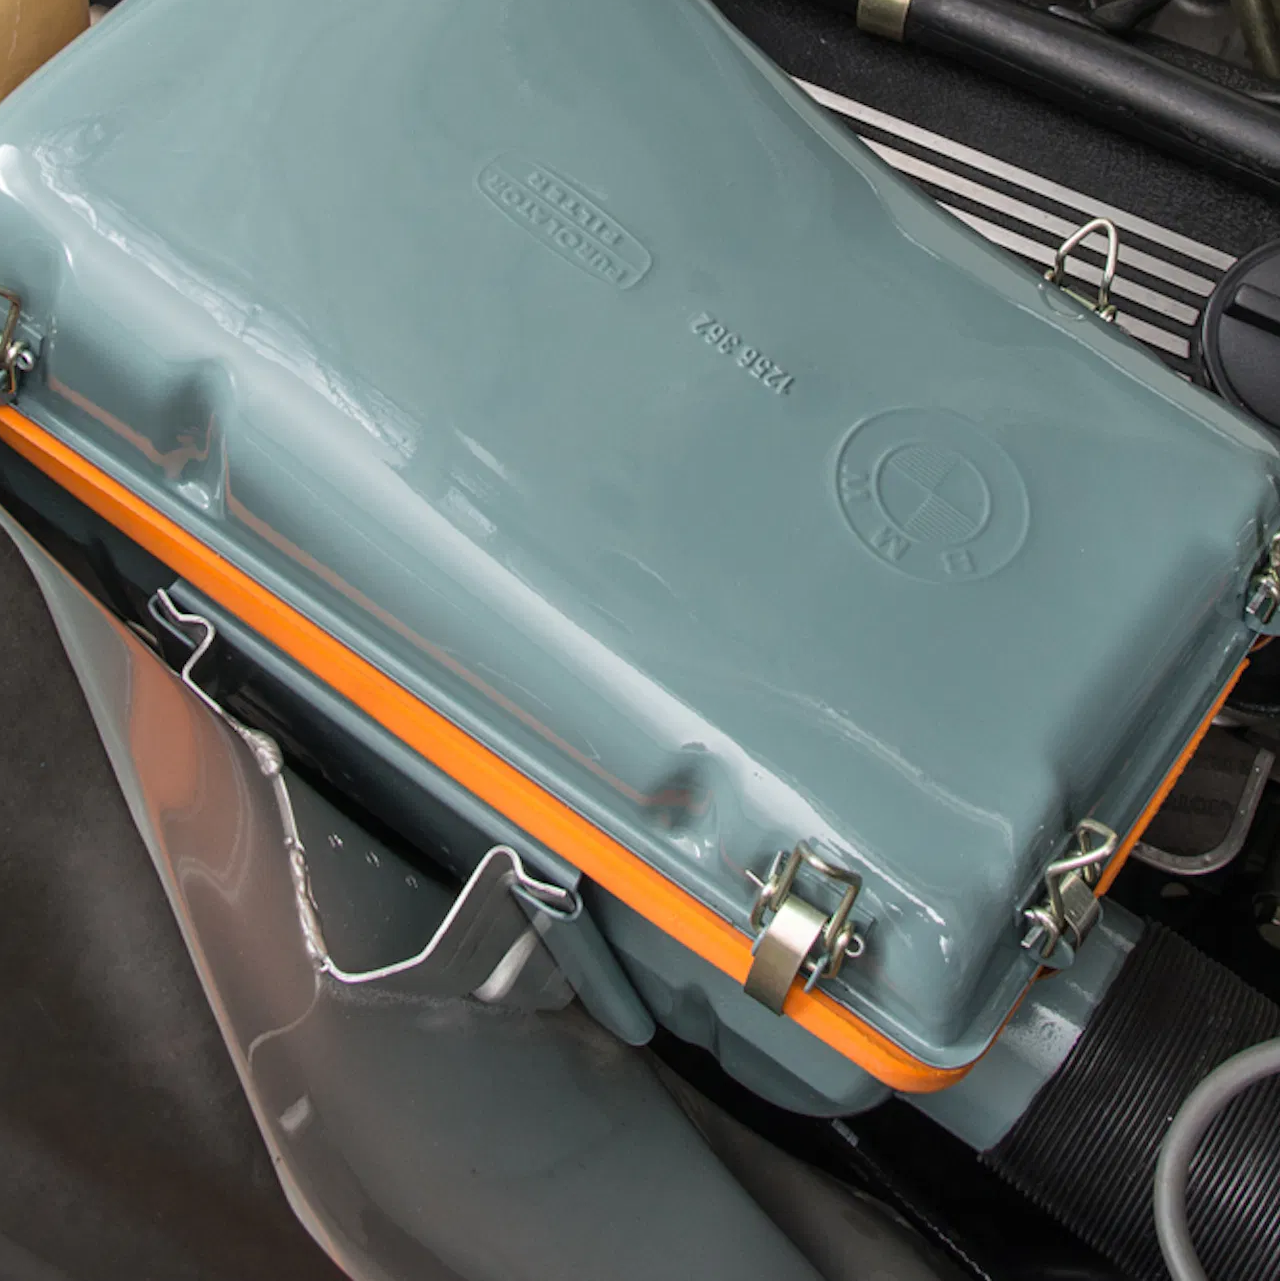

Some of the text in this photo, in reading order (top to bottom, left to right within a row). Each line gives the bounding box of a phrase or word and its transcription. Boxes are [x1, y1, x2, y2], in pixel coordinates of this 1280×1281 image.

[527, 171, 622, 246] FILTER
[736, 347, 796, 396] 1256
[841, 464, 978, 575] BMW
